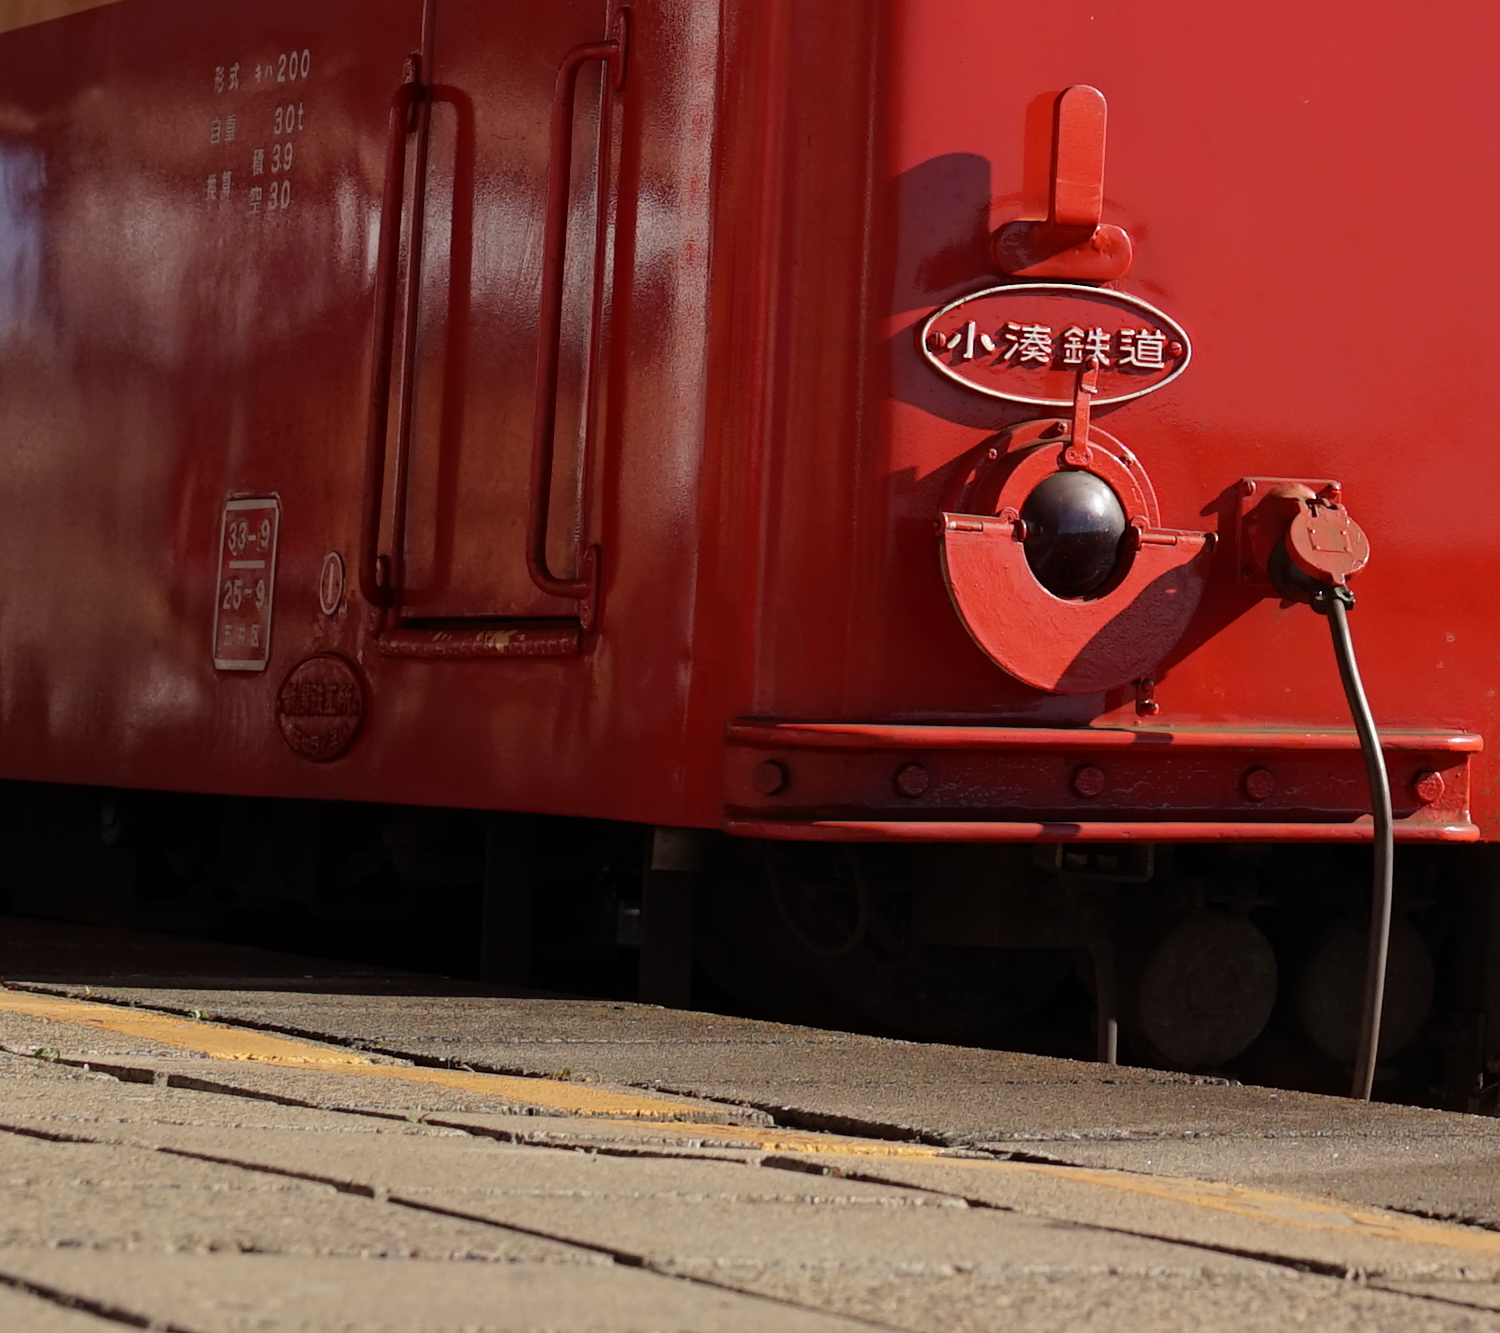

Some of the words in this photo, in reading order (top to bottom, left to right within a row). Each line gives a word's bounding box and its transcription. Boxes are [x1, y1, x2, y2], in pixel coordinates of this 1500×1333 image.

[213, 62, 240, 93] 形式
[210, 114, 237, 144] 自重
[274, 102, 304, 136] 30t
[946, 320, 1167, 369] 小湊鉄道
[222, 579, 266, 610] 25-9
